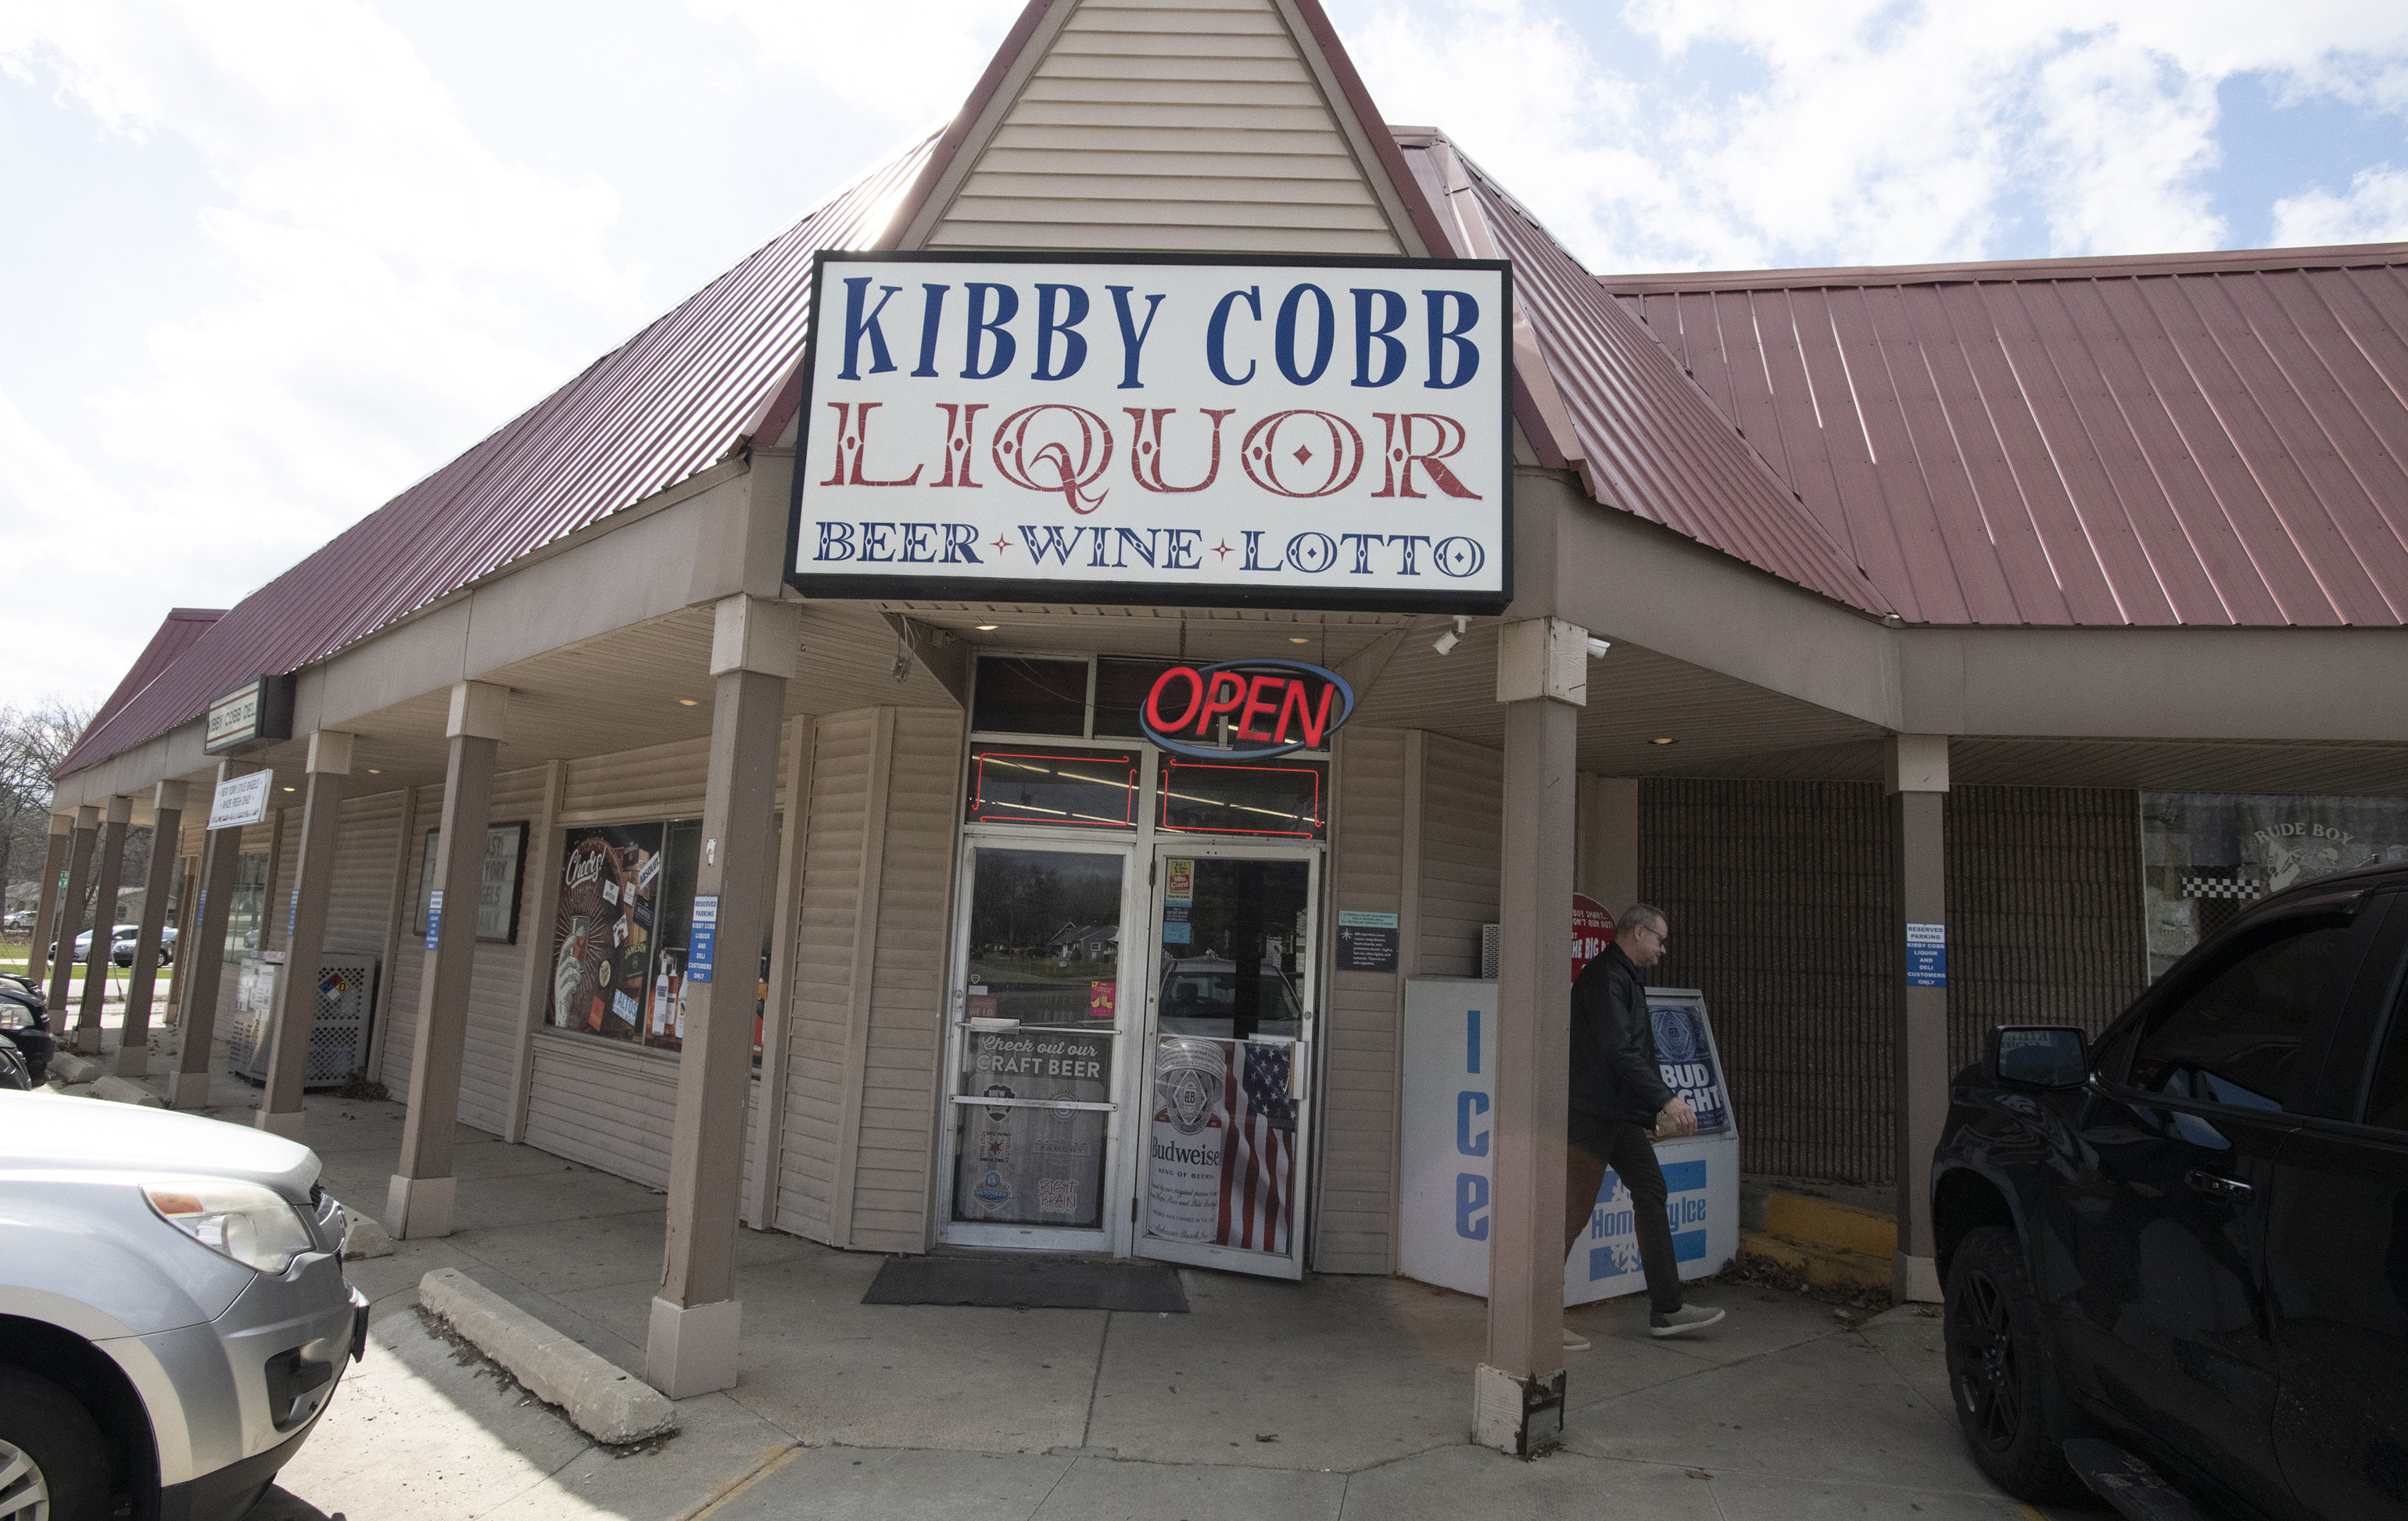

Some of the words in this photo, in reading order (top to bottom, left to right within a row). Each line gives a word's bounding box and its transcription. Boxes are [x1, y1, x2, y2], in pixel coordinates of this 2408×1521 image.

[837, 277, 1165, 389] KIBBY
[1207, 283, 1480, 389] COBB
[820, 401, 1482, 515] LIQUOR
[814, 522, 983, 564] BEER
[1018, 525, 1204, 569] WINE
[1239, 531, 1485, 578] LOTTO
[226, 708, 242, 726] COBB
[244, 703, 255, 719] DEL
[1147, 666, 1334, 748] OPEN
[2254, 823, 2306, 844] RUDE
[2313, 823, 2354, 845] BOY
[566, 845, 607, 885] Cheers!
[1573, 909, 1583, 918] BUY
[625, 943, 647, 959] JAMESON
[1572, 939, 1582, 959] HE
[1585, 938, 1599, 959] BIG
[324, 981, 330, 991] 2
[339, 982, 346, 992] 0
[969, 1008, 981, 1017] WE
[981, 1035, 1034, 1053] Check
[1037, 1042, 1065, 1055] out
[1067, 1045, 1098, 1056] our
[976, 1055, 1042, 1074] CRAFT
[1048, 1059, 1100, 1078] BEER
[1659, 1064, 1710, 1088] BUD
[1678, 1085, 1723, 1113] GHT
[1152, 1136, 1220, 1166] Budweise
[1040, 1180, 1077, 1193] RIGHT
[1039, 1193, 1076, 1207] BRAIN
[1592, 1209, 1636, 1239] Hom
[1682, 1196, 1706, 1224] Ice
